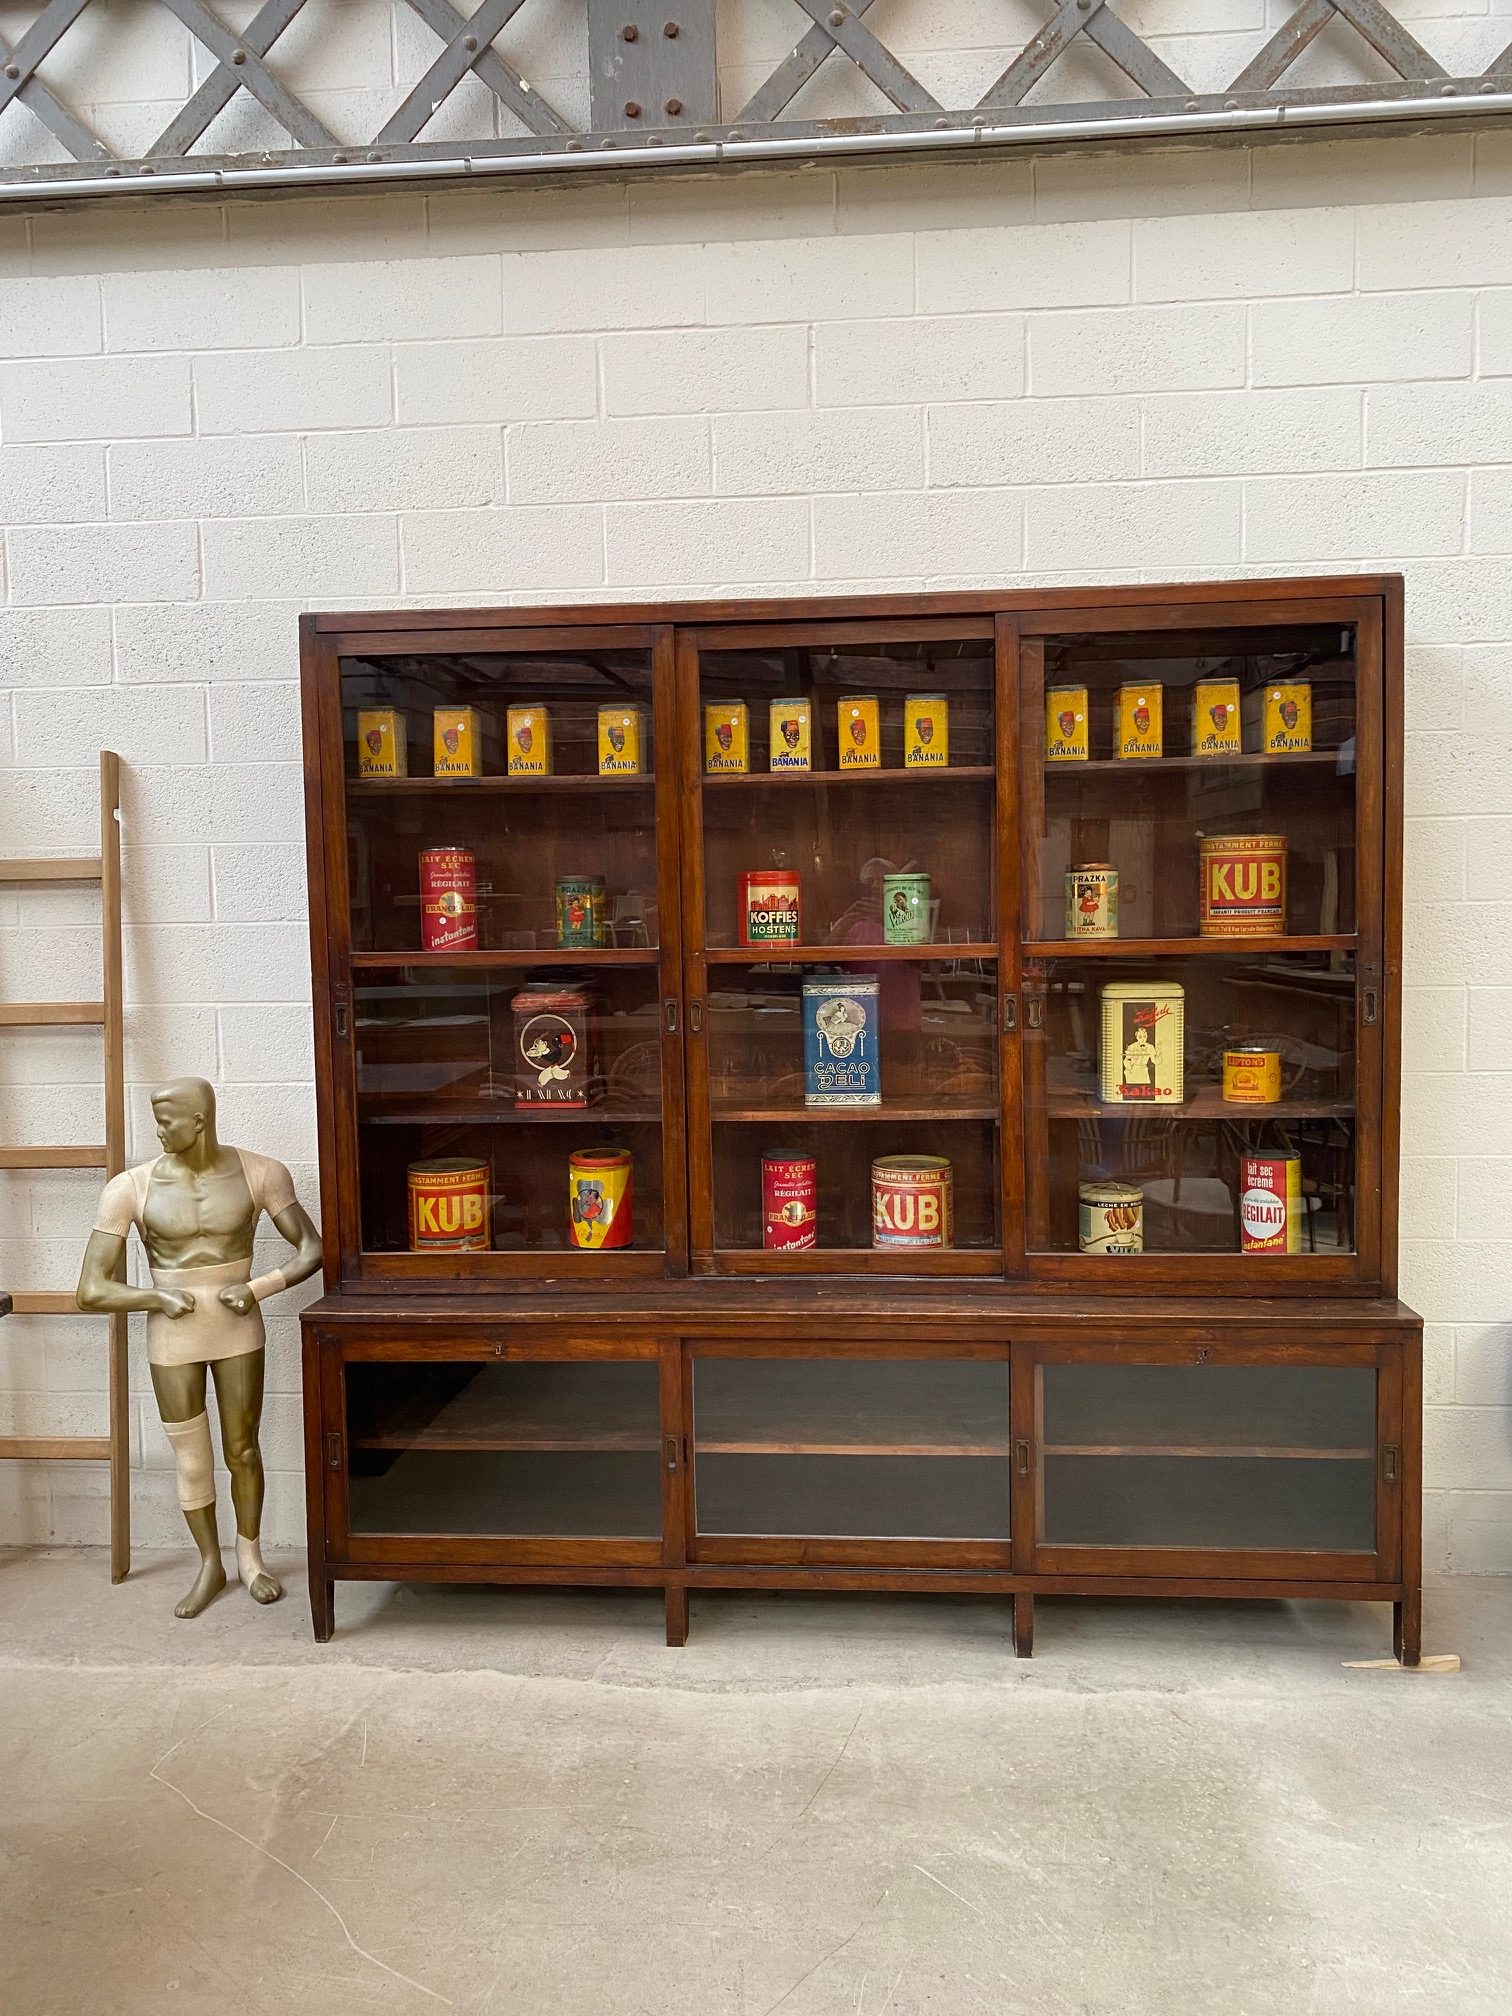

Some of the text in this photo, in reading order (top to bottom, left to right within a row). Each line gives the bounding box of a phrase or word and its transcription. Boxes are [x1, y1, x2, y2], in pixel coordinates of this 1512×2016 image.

[1123, 743, 1160, 753] BANANIA
[1201, 740, 1239, 750] BANANIA
[1270, 738, 1309, 748] BANANIA
[1049, 747, 1085, 756] BANANIA
[772, 757, 808, 767] BANANIA
[842, 754, 877, 764] BANANIA
[907, 753, 943, 762] BANANIA
[359, 764, 393, 773] BANANIA
[435, 762, 470, 772] BANANIA
[509, 762, 543, 771] BANANIA
[601, 760, 637, 770] BANANIA
[708, 759, 743, 769] BANANIA
[1212, 862, 1281, 901] KUB
[750, 910, 798, 924] KOFFIES
[752, 925, 796, 935] HOSTENS
[814, 1062, 870, 1075] CACAO
[764, 1164, 785, 1173] LAIT
[1247, 1161, 1273, 1177] lait sec
[784, 1171, 804, 1179] SEC
[418, 1193, 482, 1232] KUB
[876, 1191, 940, 1231] KUB
